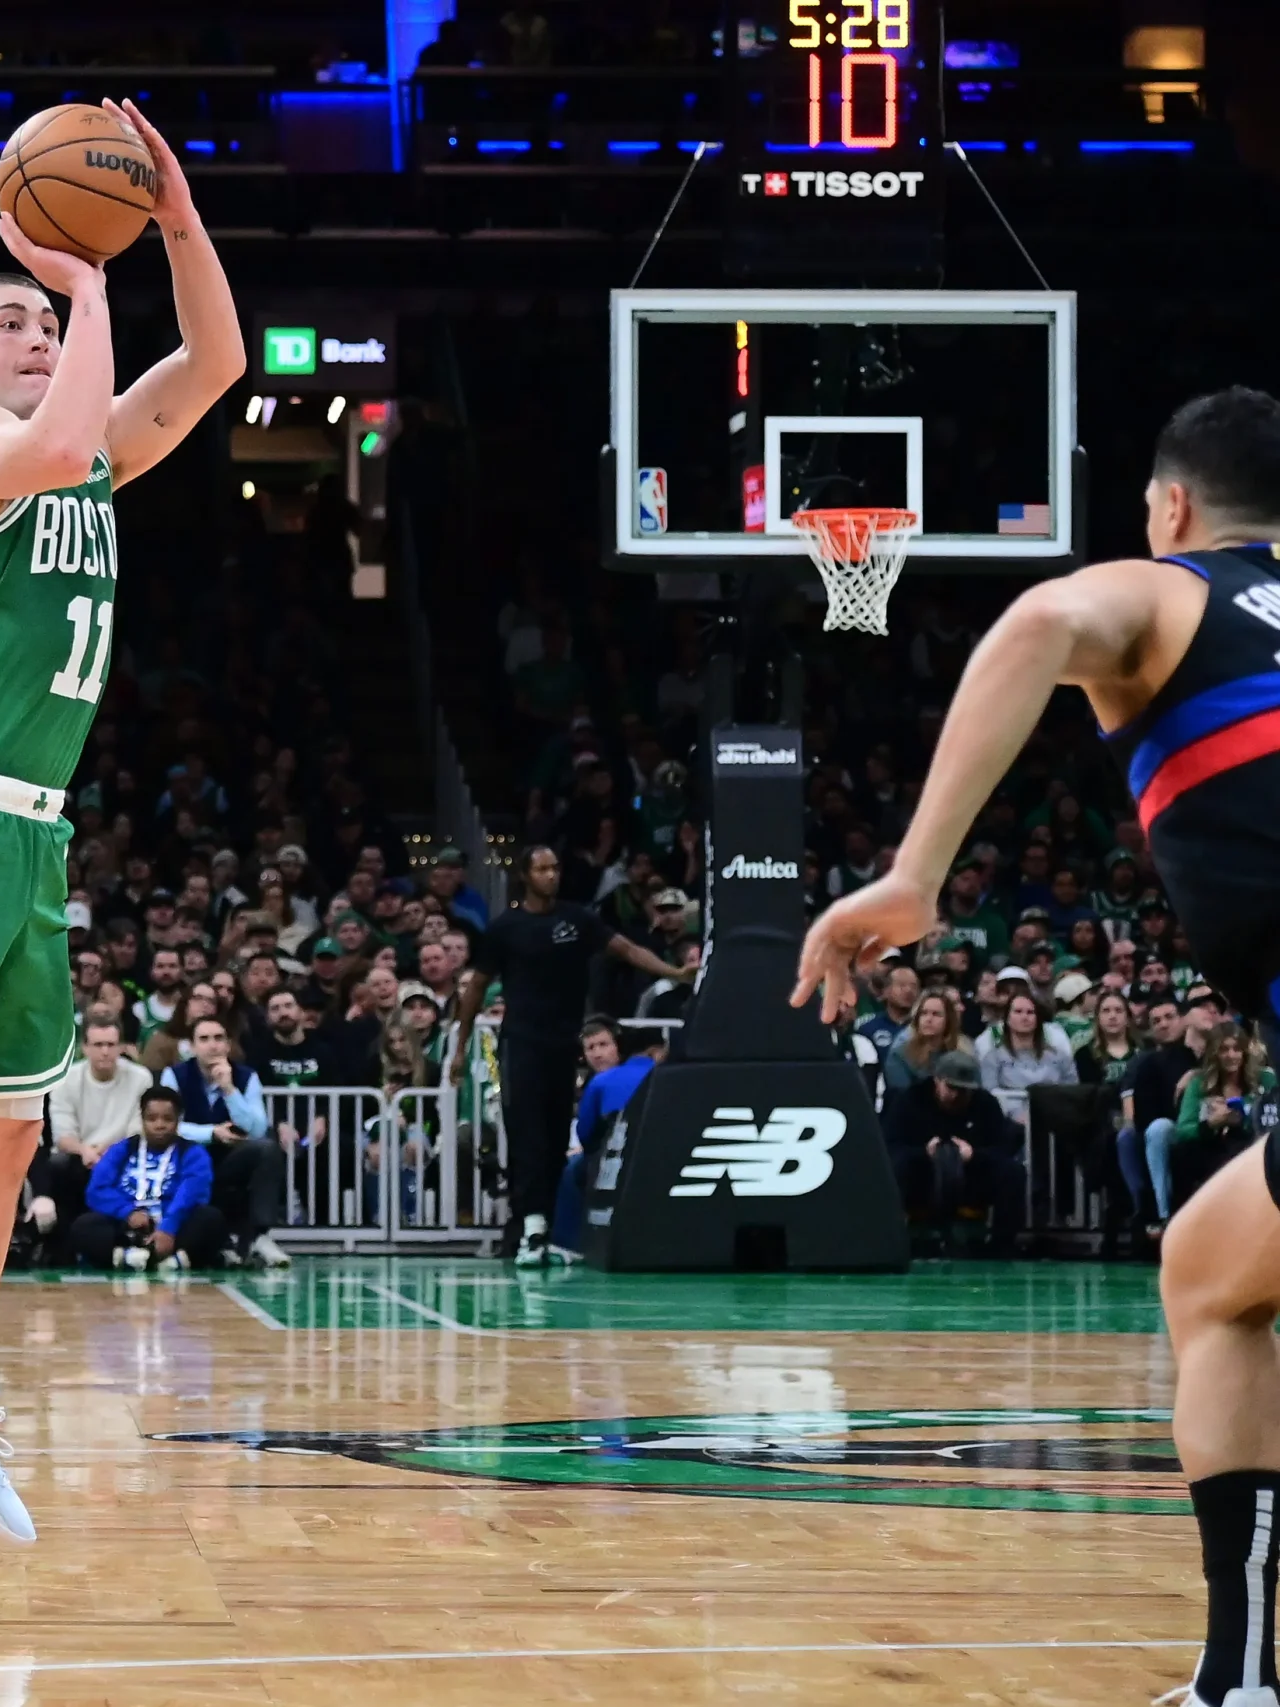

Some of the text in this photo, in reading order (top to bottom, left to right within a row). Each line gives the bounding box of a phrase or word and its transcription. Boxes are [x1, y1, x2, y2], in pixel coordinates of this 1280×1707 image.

[789, 0, 909, 48] 5:28
[809, 53, 896, 148] 10
[790, 171, 925, 197] TISSOT
[270, 335, 387, 366] TD Bank
[49, 595, 113, 704] 11
[721, 853, 799, 879] Amica
